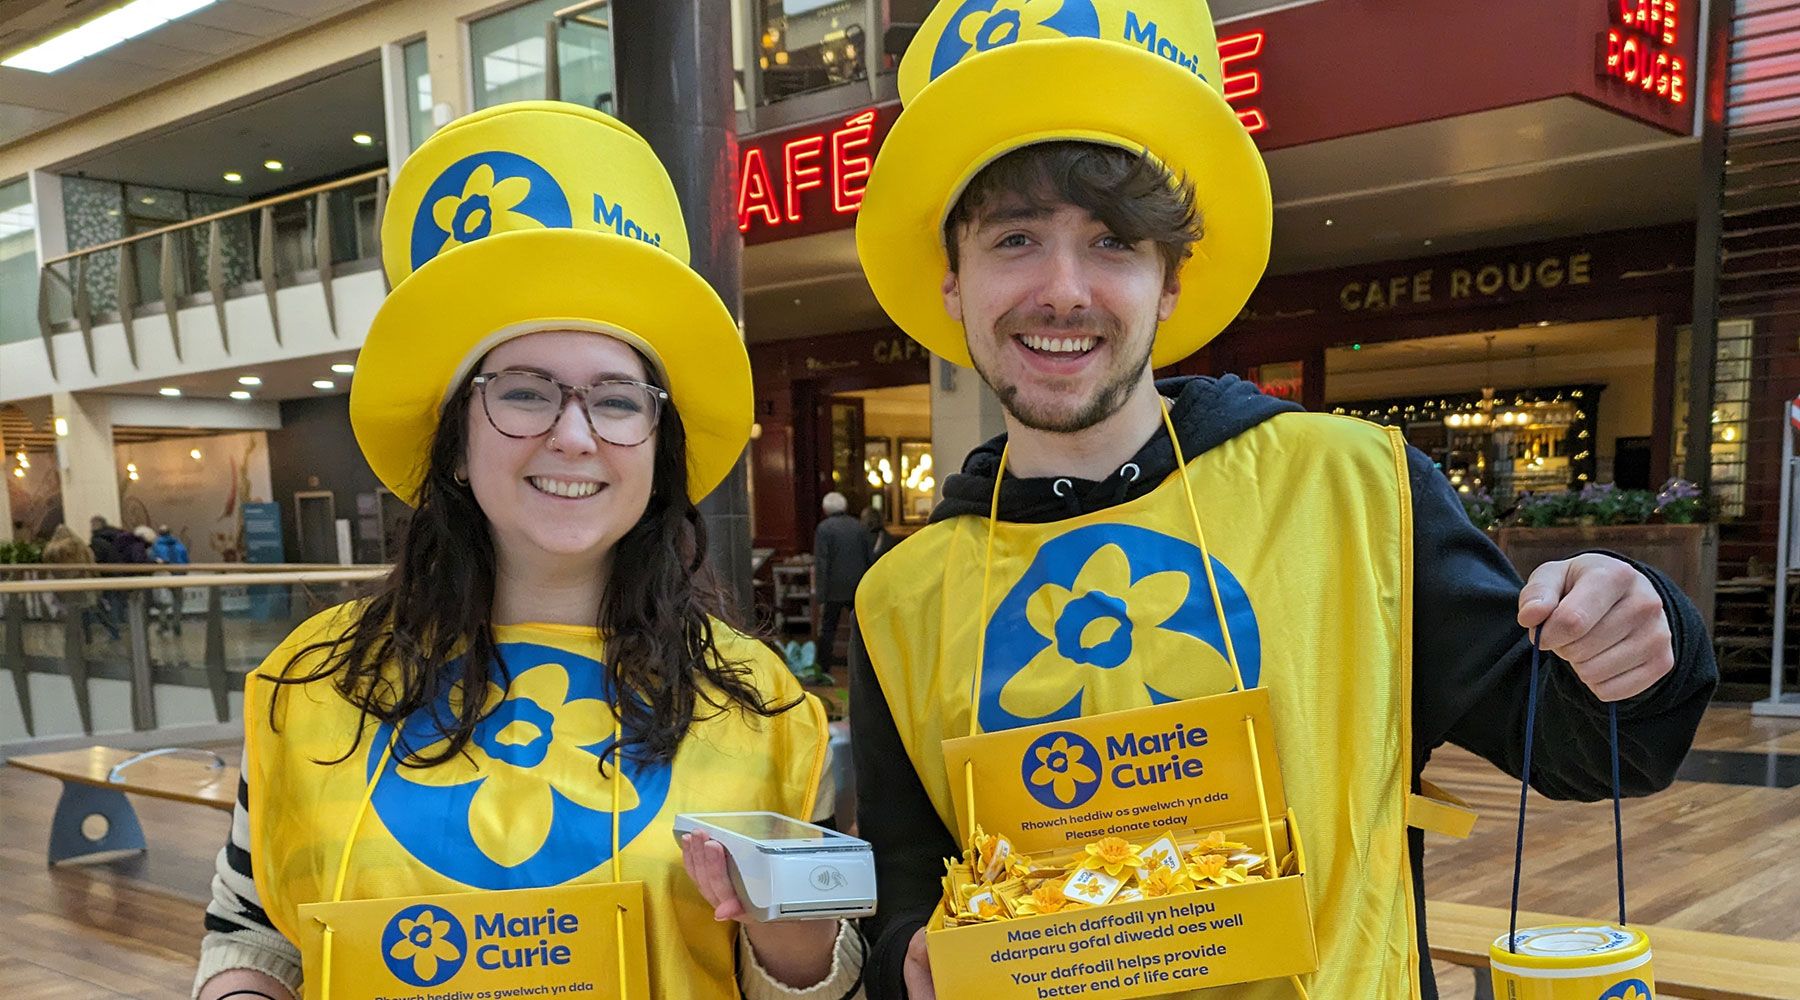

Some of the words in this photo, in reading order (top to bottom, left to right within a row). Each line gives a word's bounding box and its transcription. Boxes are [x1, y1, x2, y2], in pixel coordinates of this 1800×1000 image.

[1606, 32, 1684, 102] ROUGE
[1450, 252, 1592, 299] ROUGE
[1106, 723, 1208, 760] Marie
[1111, 754, 1204, 789] Curie
[1021, 816, 1067, 831] Rhowch
[1070, 809, 1113, 824] heddiw
[1116, 807, 1130, 817] os
[1132, 799, 1185, 816] gwelwch
[1187, 797, 1202, 808] yn
[1204, 791, 1229, 804] dda
[1065, 826, 1105, 841] Please
[1107, 821, 1150, 835] donate
[1152, 815, 1188, 830] today
[474, 907, 579, 940] Marie
[990, 944, 1066, 963] ddarparu
[1069, 933, 1111, 954] gofal
[1114, 925, 1174, 945] diwedd
[1177, 922, 1207, 935] oes
[1209, 914, 1244, 930] well
[1007, 928, 1041, 943] Mae
[1044, 922, 1077, 937] eich
[1080, 911, 1144, 932] daffodil
[1147, 910, 1167, 926] yn
[1169, 902, 1216, 921] helpu
[476, 939, 571, 970] Curie
[1011, 971, 1047, 986] Your
[1050, 957, 1114, 980] daffodil
[1117, 951, 1161, 970] helps
[1164, 944, 1227, 966] provide
[476, 990, 491, 999] os
[494, 985, 549, 999] gwelwch
[551, 984, 567, 997] yn
[569, 982, 593, 992] dda
[1037, 983, 1087, 999] better
[1090, 976, 1120, 990] end
[1123, 972, 1142, 987] of
[1144, 968, 1169, 984] life
[1172, 965, 1209, 980] care
